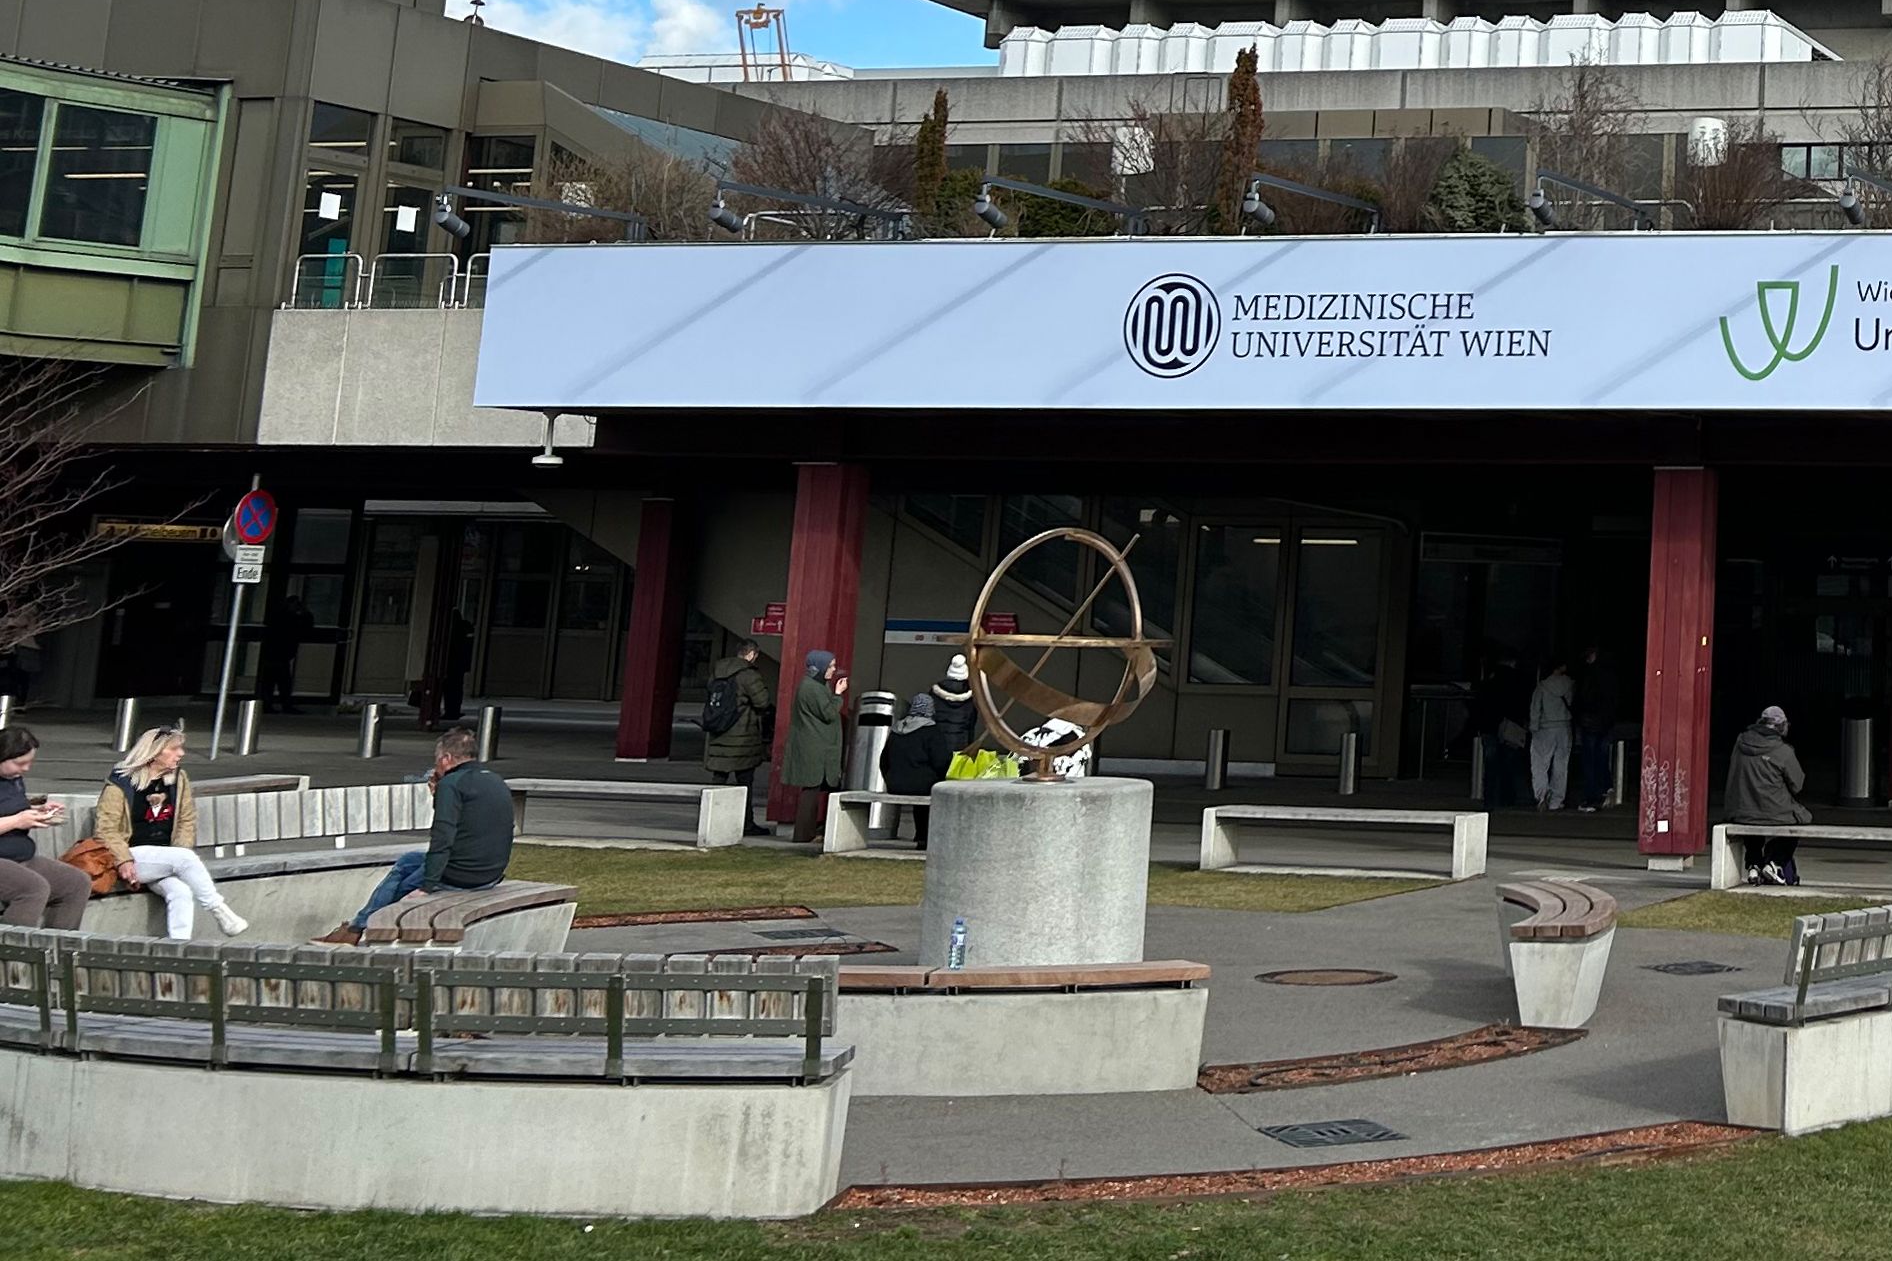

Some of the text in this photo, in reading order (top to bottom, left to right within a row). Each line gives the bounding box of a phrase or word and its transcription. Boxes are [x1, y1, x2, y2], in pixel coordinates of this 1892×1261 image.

[1232, 293, 1475, 321] MEDIZINISCHE
[1232, 324, 1552, 358] UNIVERSITÄT WIEN
[237, 567, 258, 580] Ende
